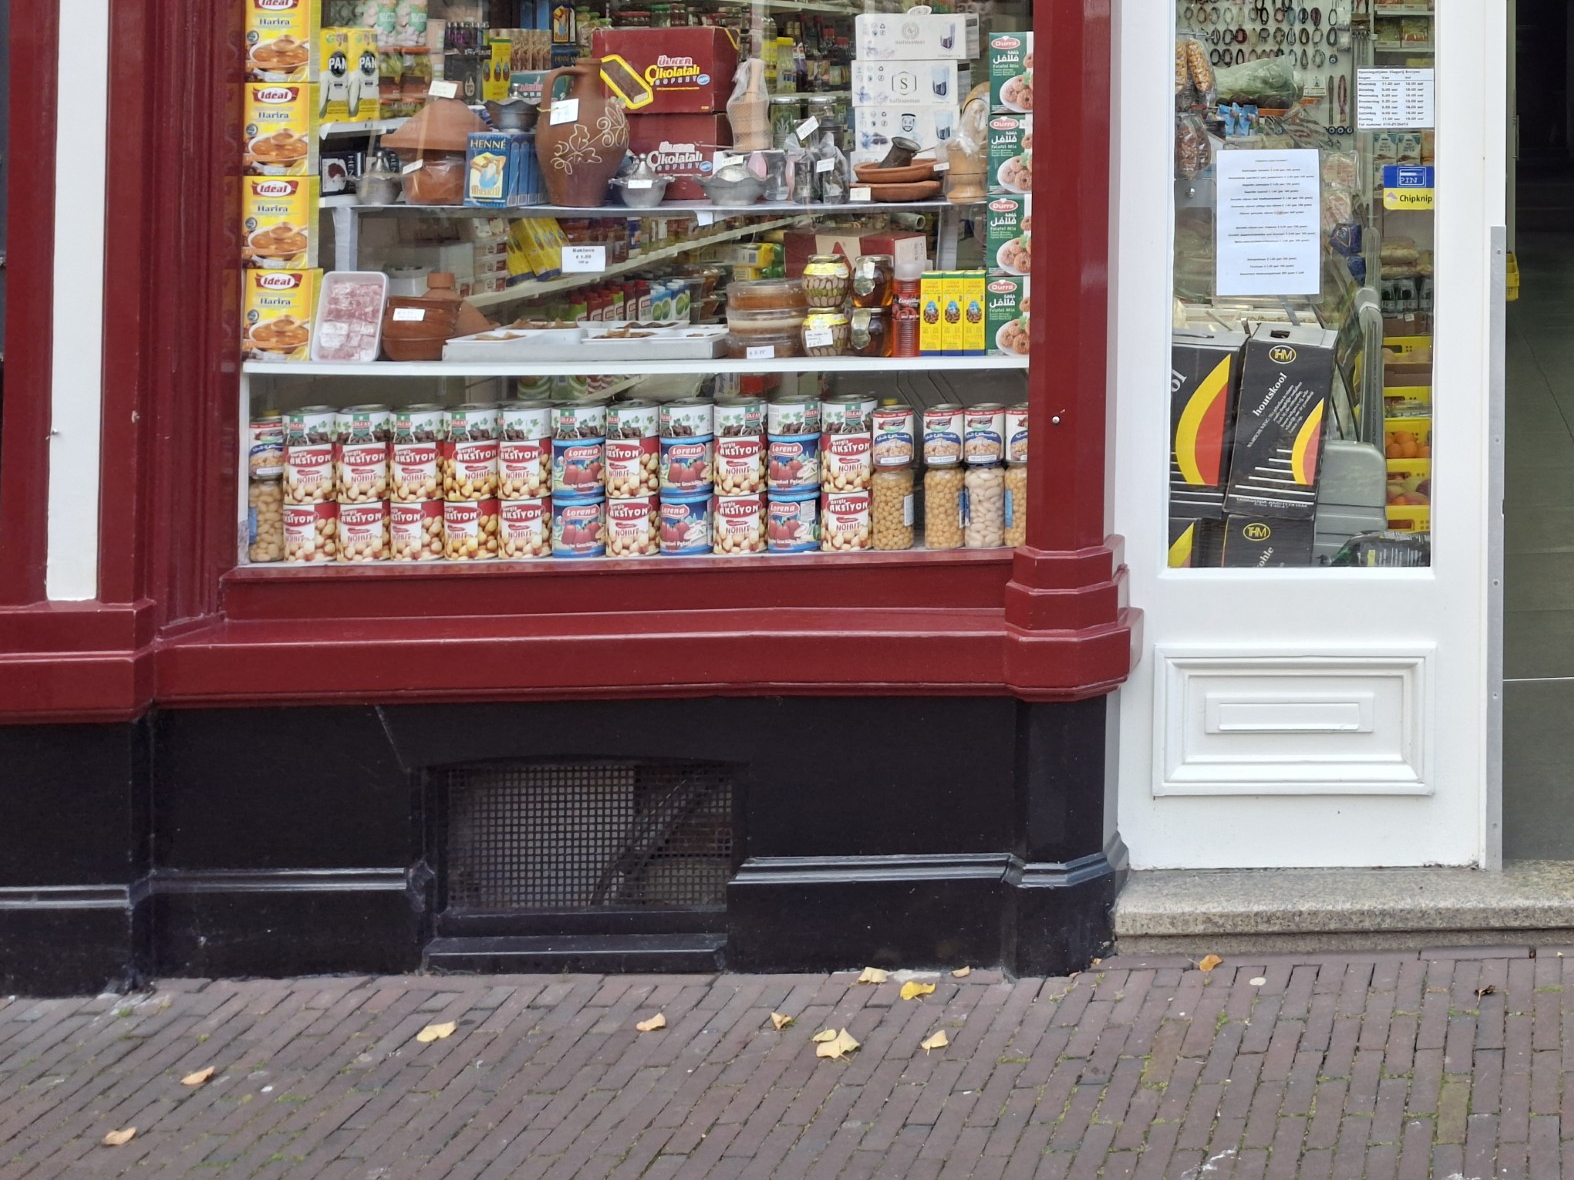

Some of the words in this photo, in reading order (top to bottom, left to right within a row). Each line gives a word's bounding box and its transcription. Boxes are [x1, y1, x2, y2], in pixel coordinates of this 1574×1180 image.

[470, 138, 507, 150] HENNÉ
[1399, 194, 1433, 204] Chipknip
[1252, 371, 1287, 417] houtskool
[568, 448, 599, 457] Lorena
[672, 446, 702, 455] Lorena
